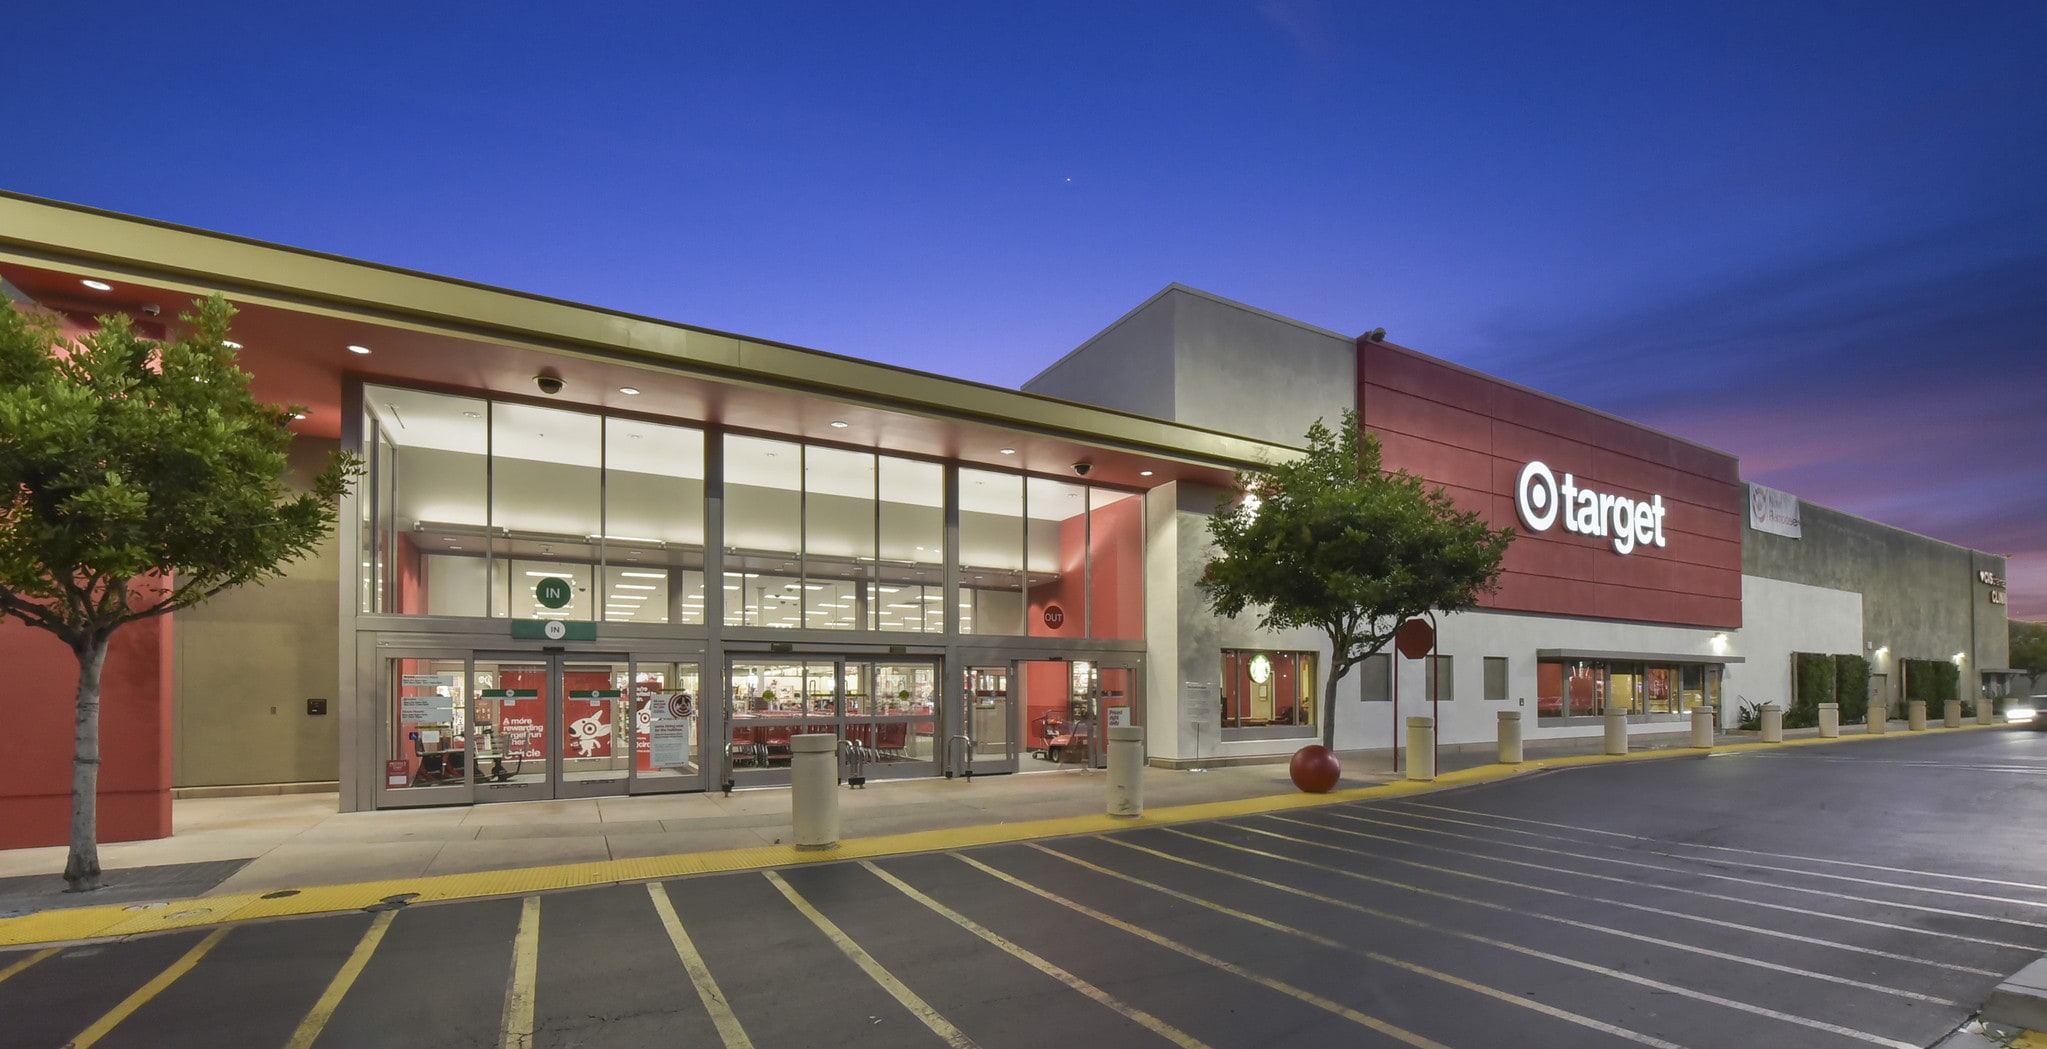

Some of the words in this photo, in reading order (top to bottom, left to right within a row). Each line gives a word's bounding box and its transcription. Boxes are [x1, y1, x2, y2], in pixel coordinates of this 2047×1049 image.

[1561, 473, 1665, 555] target
[546, 587, 560, 599] IN
[1045, 613, 1062, 622] OUT
[503, 717, 510, 725] A
